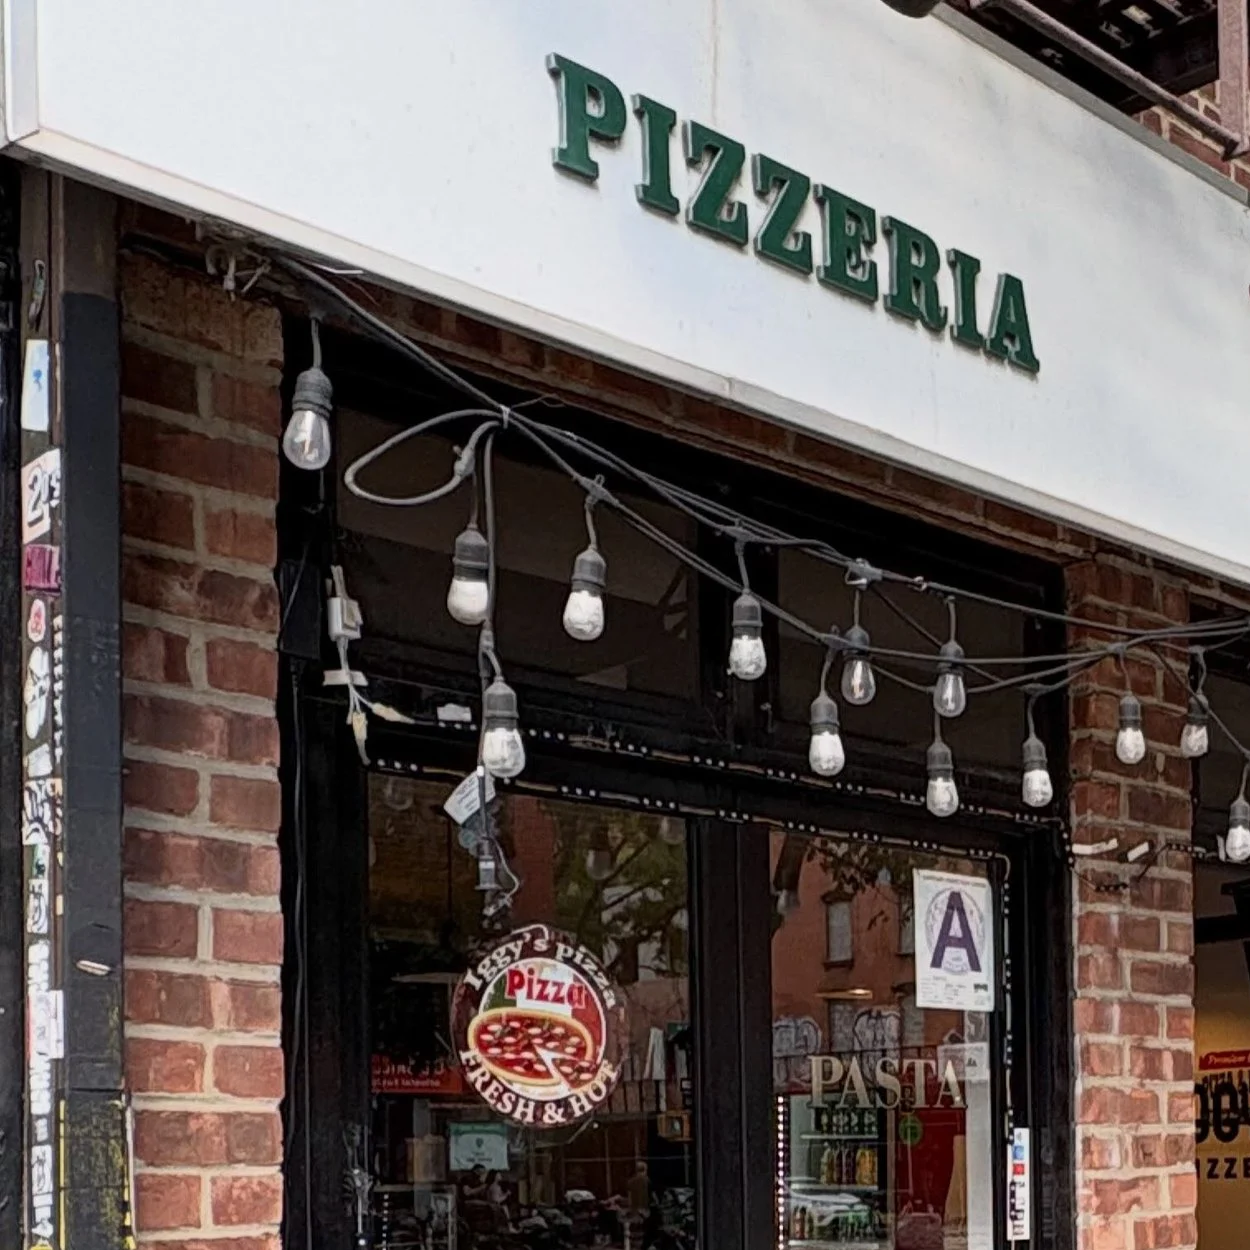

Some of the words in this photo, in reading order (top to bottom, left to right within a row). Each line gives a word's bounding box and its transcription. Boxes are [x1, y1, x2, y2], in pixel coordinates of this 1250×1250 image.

[545, 52, 1040, 374] PIZZERIA
[929, 890, 982, 973] A
[505, 967, 586, 1010] Pizza
[459, 1049, 536, 1123] FRESH
[570, 1059, 618, 1118] HOT
[807, 1054, 969, 1110] PASTA
